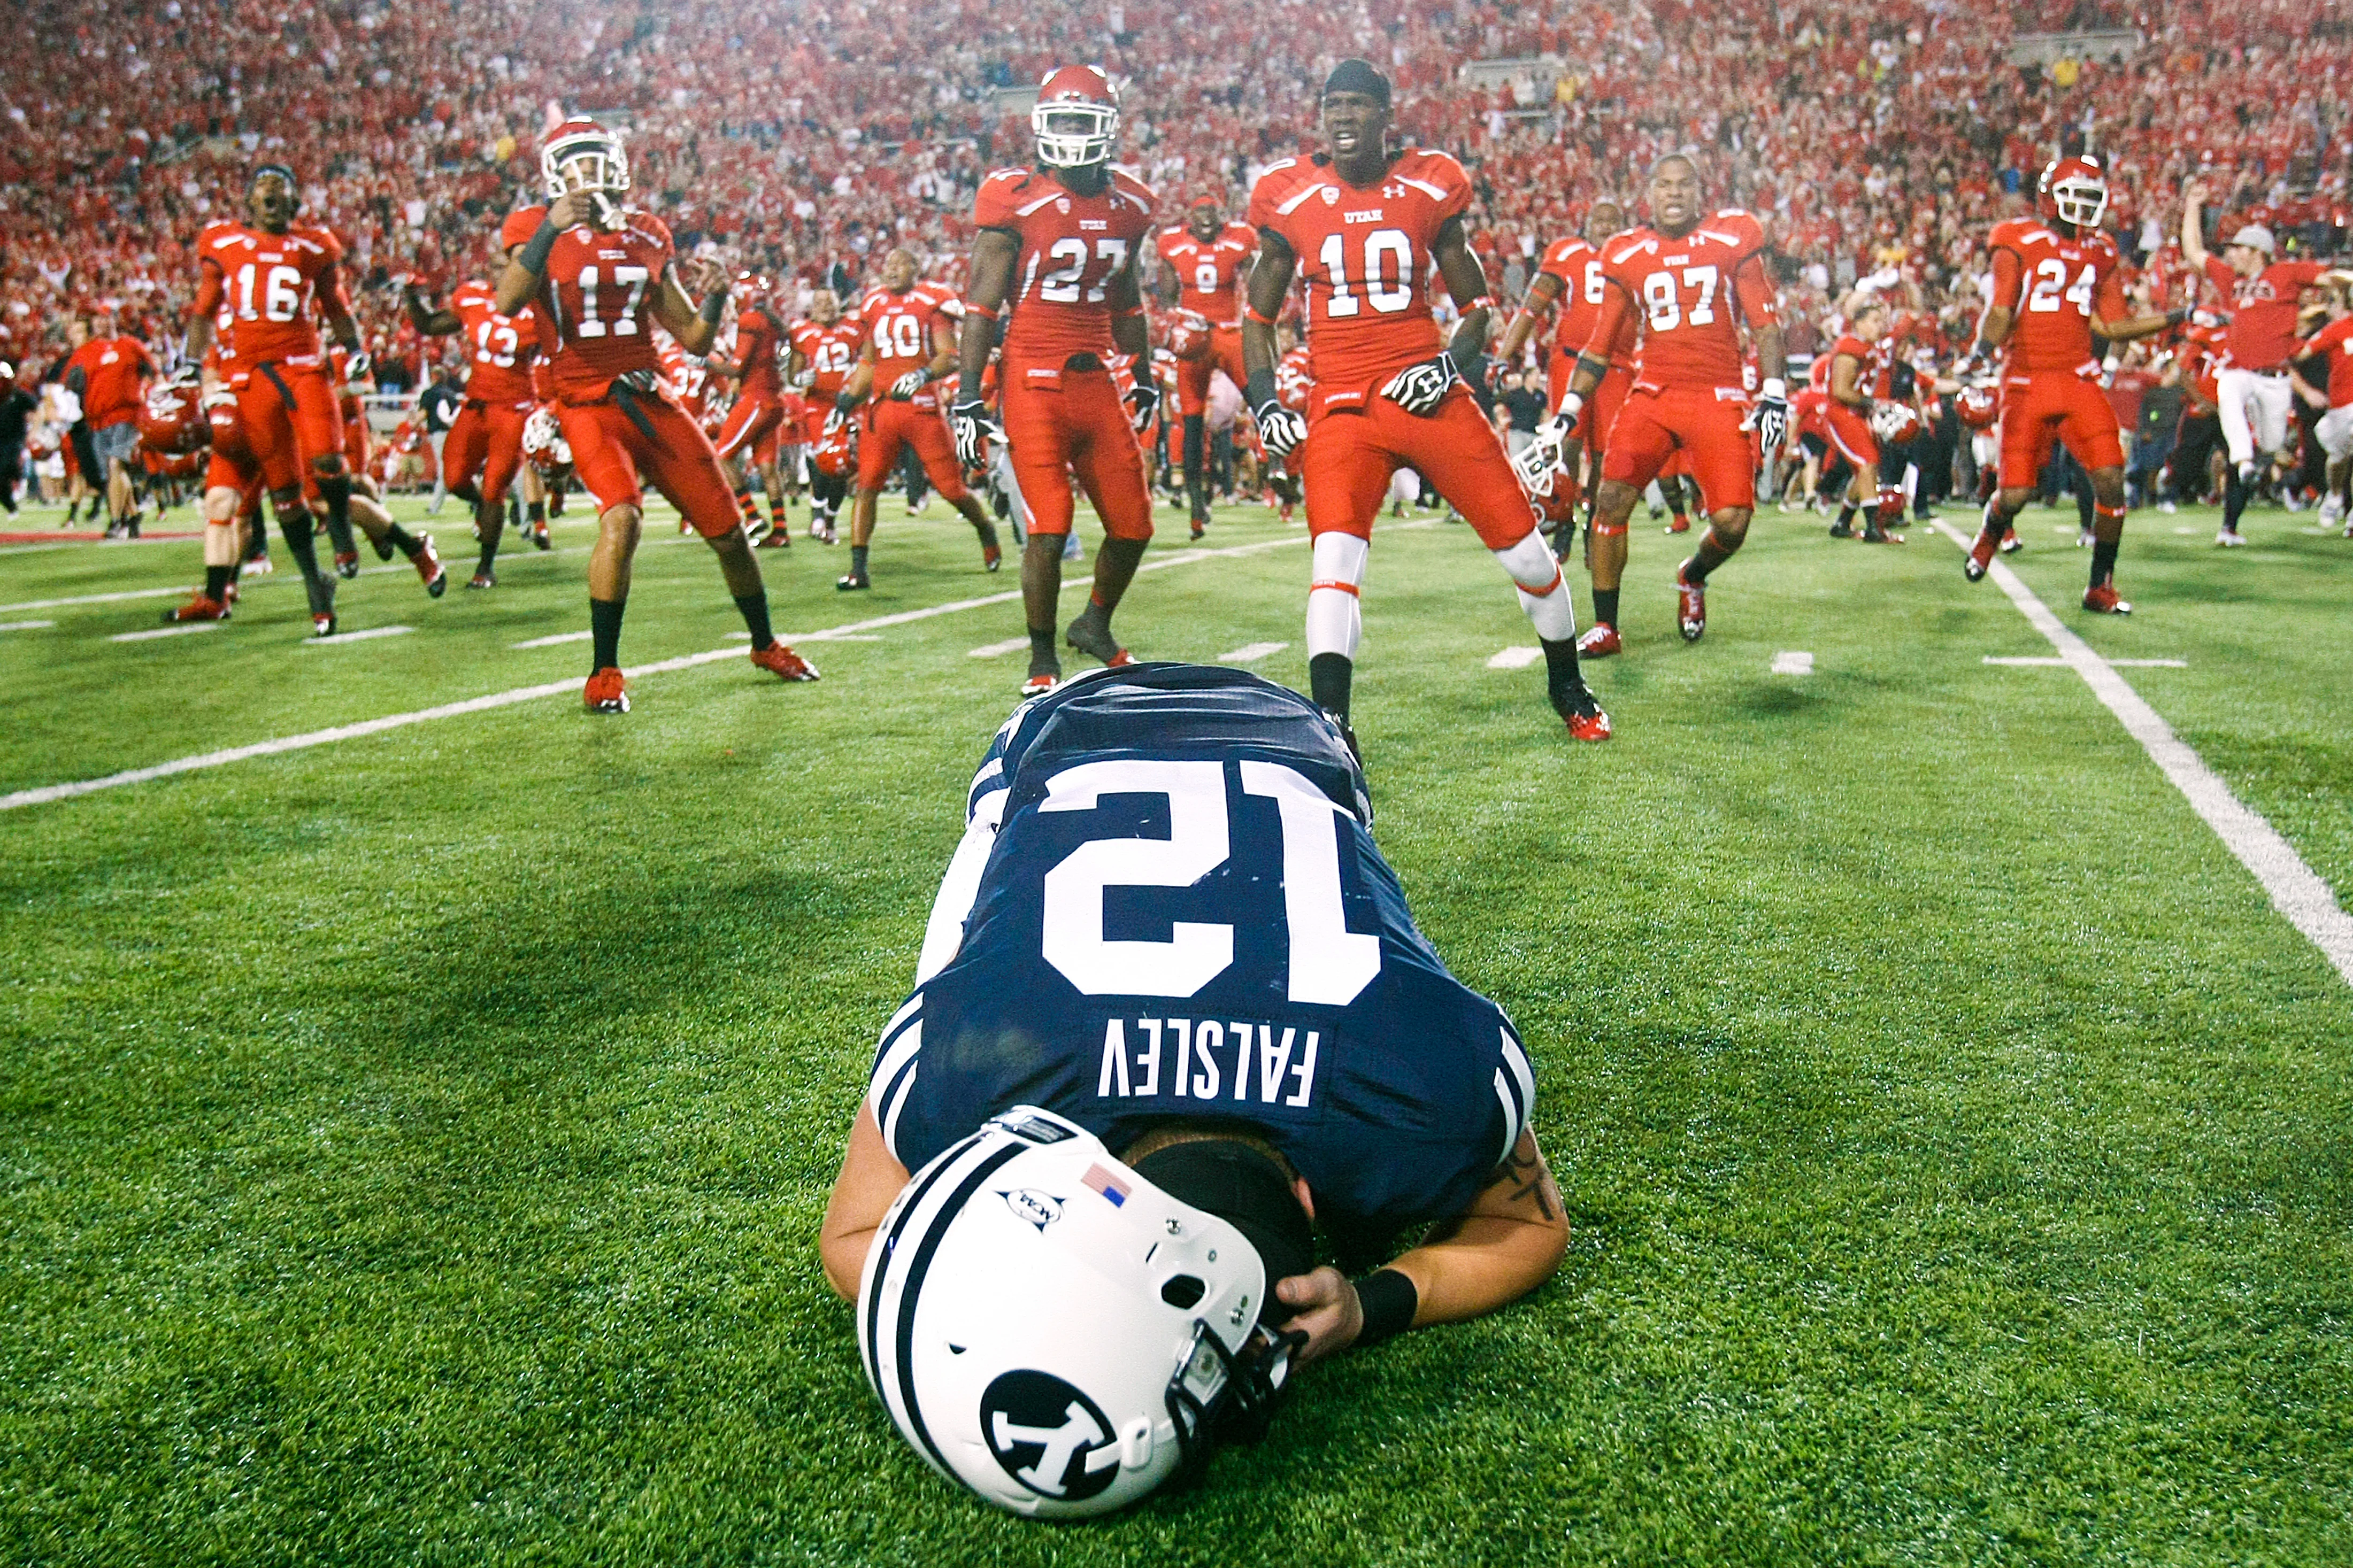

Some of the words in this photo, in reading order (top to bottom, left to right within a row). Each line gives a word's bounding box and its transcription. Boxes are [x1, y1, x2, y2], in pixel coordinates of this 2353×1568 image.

[1343, 209, 1383, 224] UTAH
[237, 263, 301, 322] 16
[1041, 237, 1126, 303] 27
[1320, 229, 1413, 318] 10
[1644, 265, 1717, 332] 87
[2029, 258, 2096, 317] 24
[578, 265, 649, 338] 17
[476, 320, 519, 368] 13
[814, 342, 851, 373] 42
[873, 314, 920, 359] 40
[673, 367, 706, 398] 37
[1037, 760, 1381, 1006] 12
[1098, 1018, 1319, 1107] FALSLEV
[992, 1399, 1105, 1495] Y
